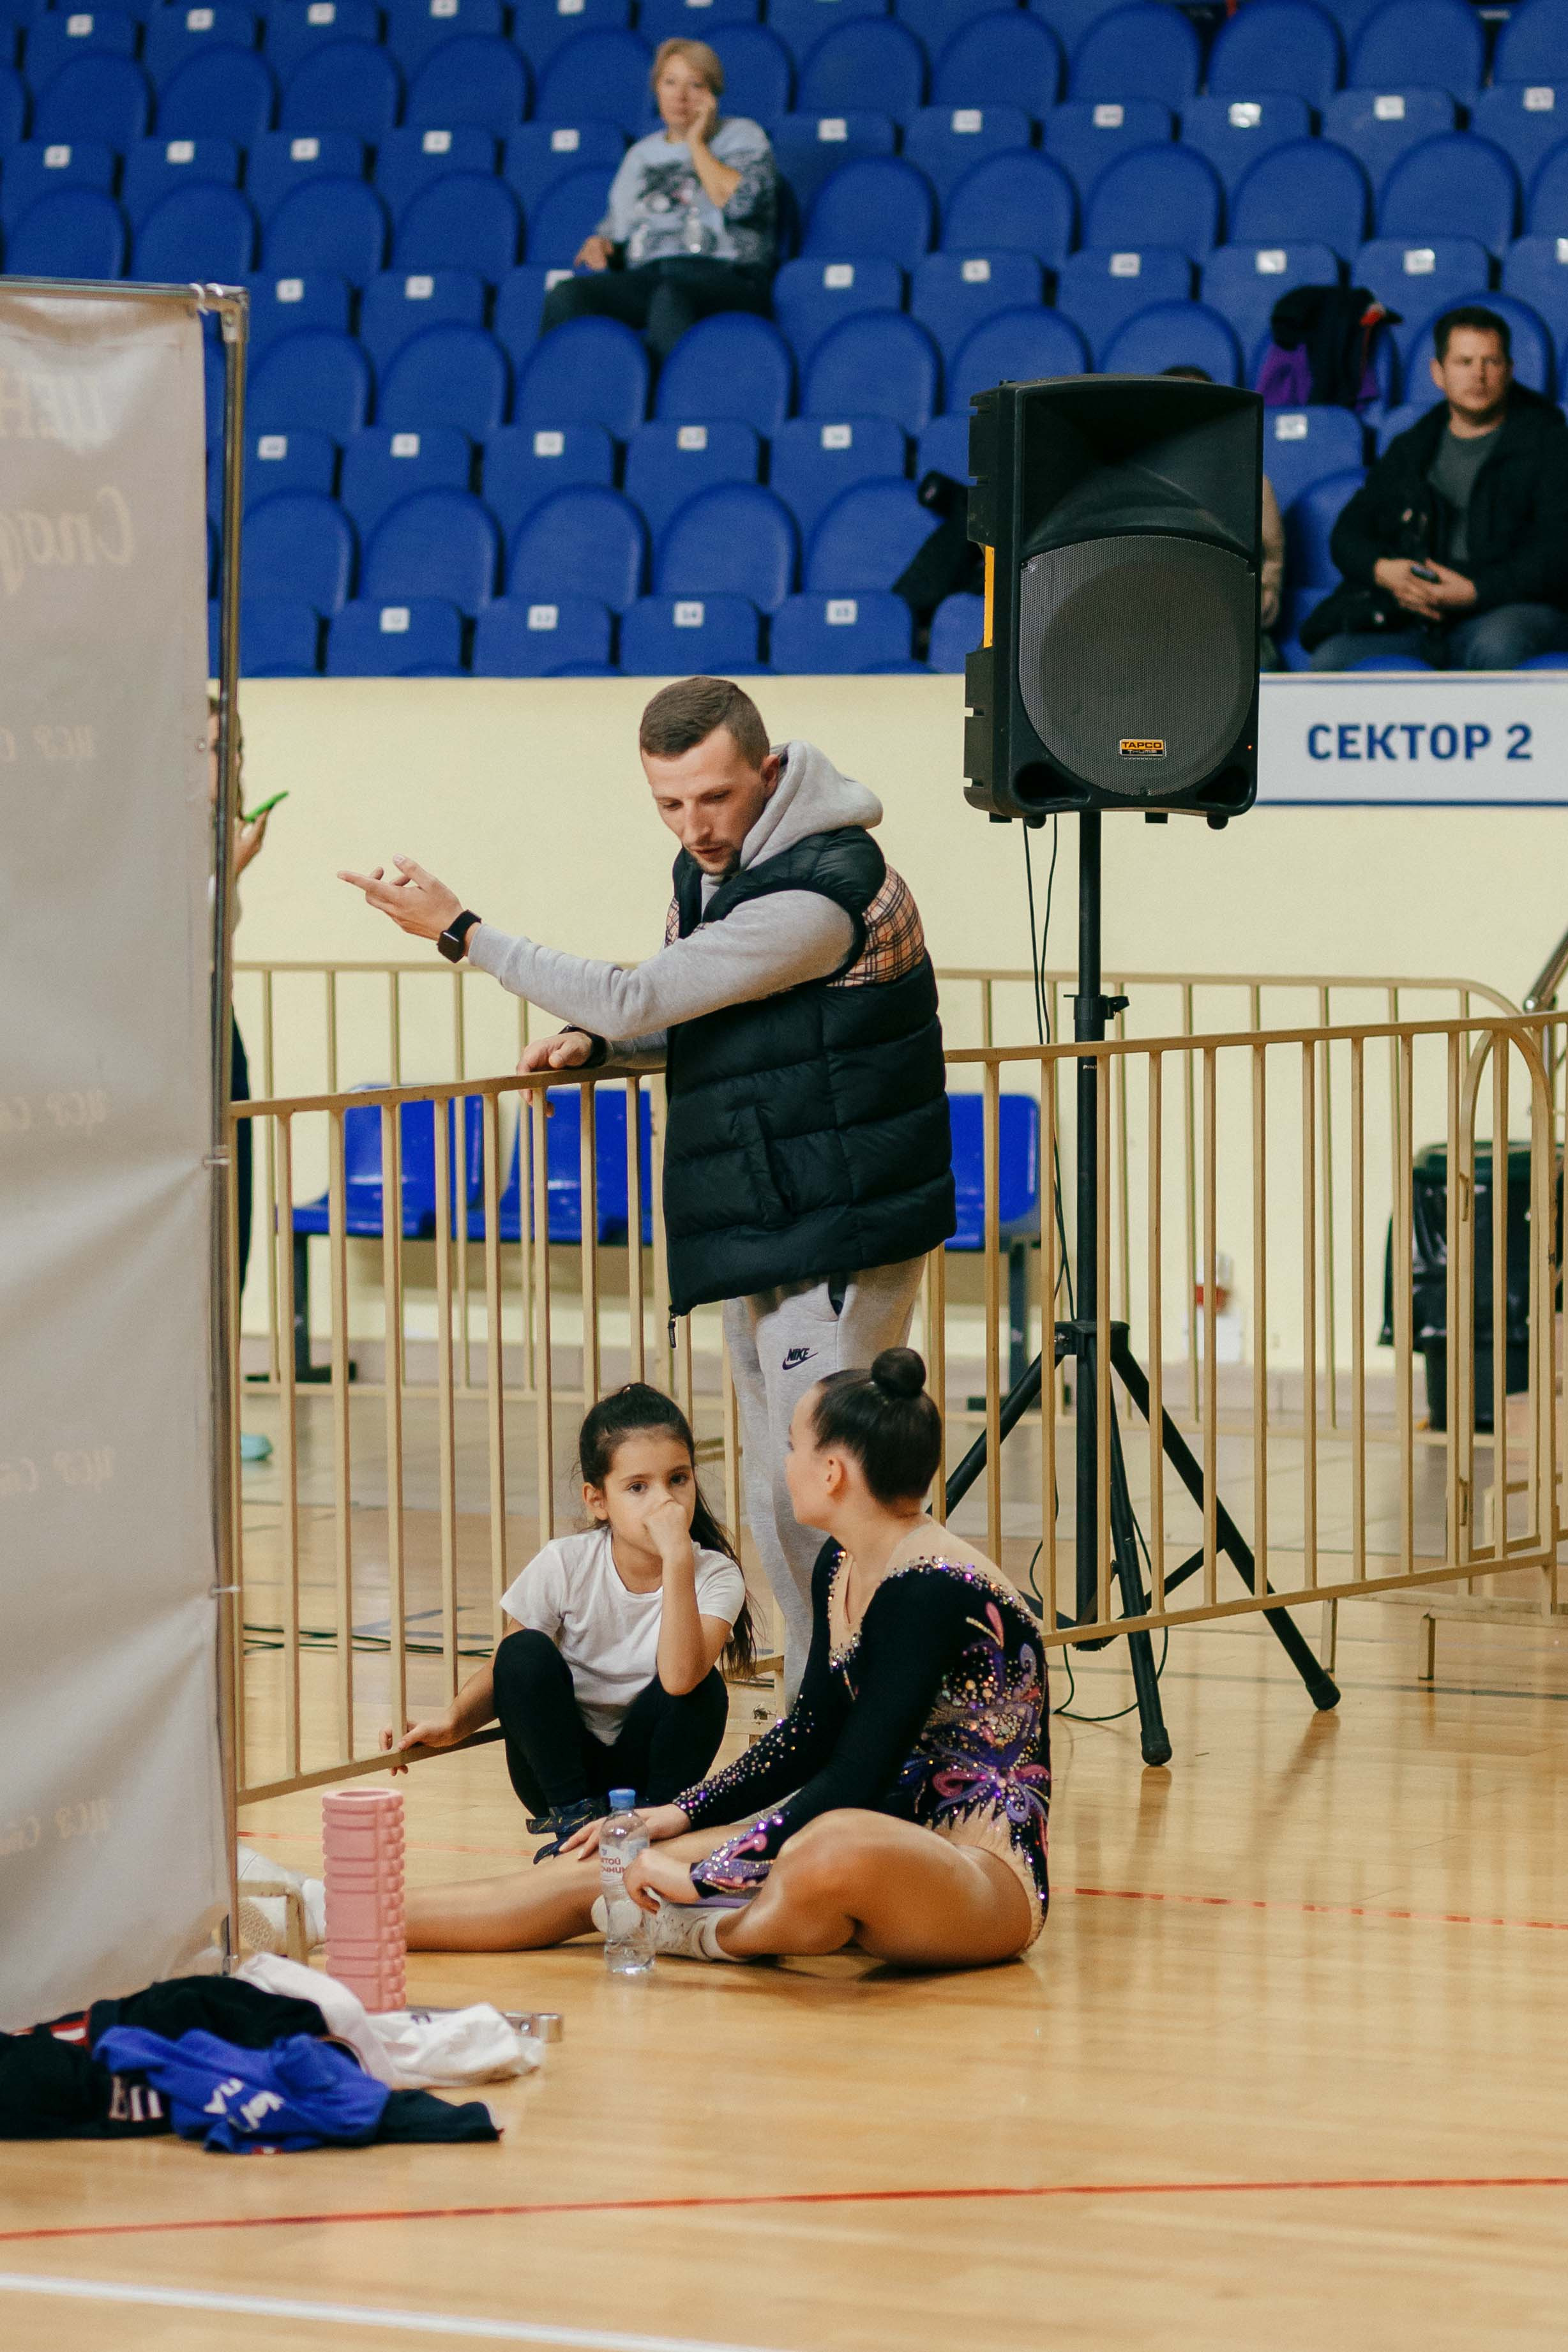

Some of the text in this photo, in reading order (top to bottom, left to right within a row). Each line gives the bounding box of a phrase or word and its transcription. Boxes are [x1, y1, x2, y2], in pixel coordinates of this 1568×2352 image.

[1308, 723, 1533, 760] СЕКТОР 2
[786, 1348, 810, 1362] NIKE
